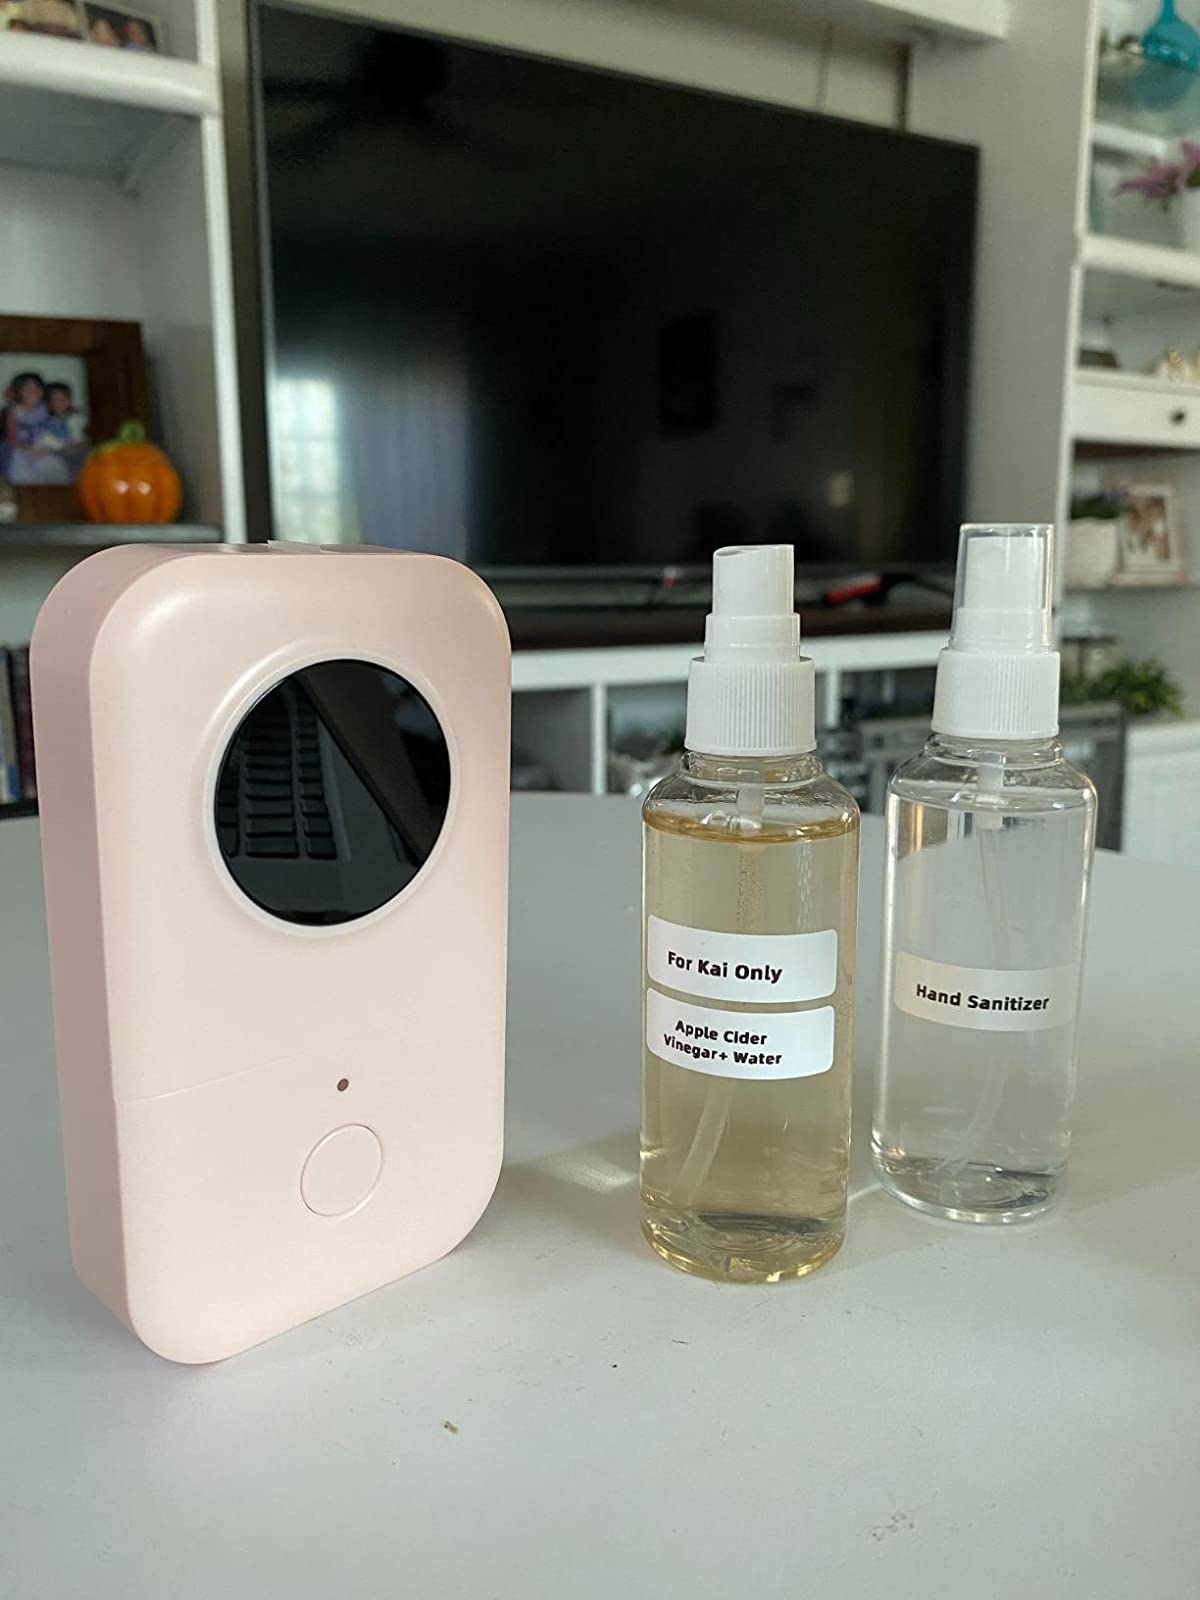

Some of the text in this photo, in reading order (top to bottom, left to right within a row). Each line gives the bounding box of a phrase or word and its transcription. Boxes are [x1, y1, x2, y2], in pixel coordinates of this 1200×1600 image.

[668, 950, 783, 985] For Kai Only
[916, 983, 1050, 1012] Hand Sanitizer
[675, 1019, 768, 1045] Apple Cider
[663, 1033, 783, 1066] Vinegar+ Water
